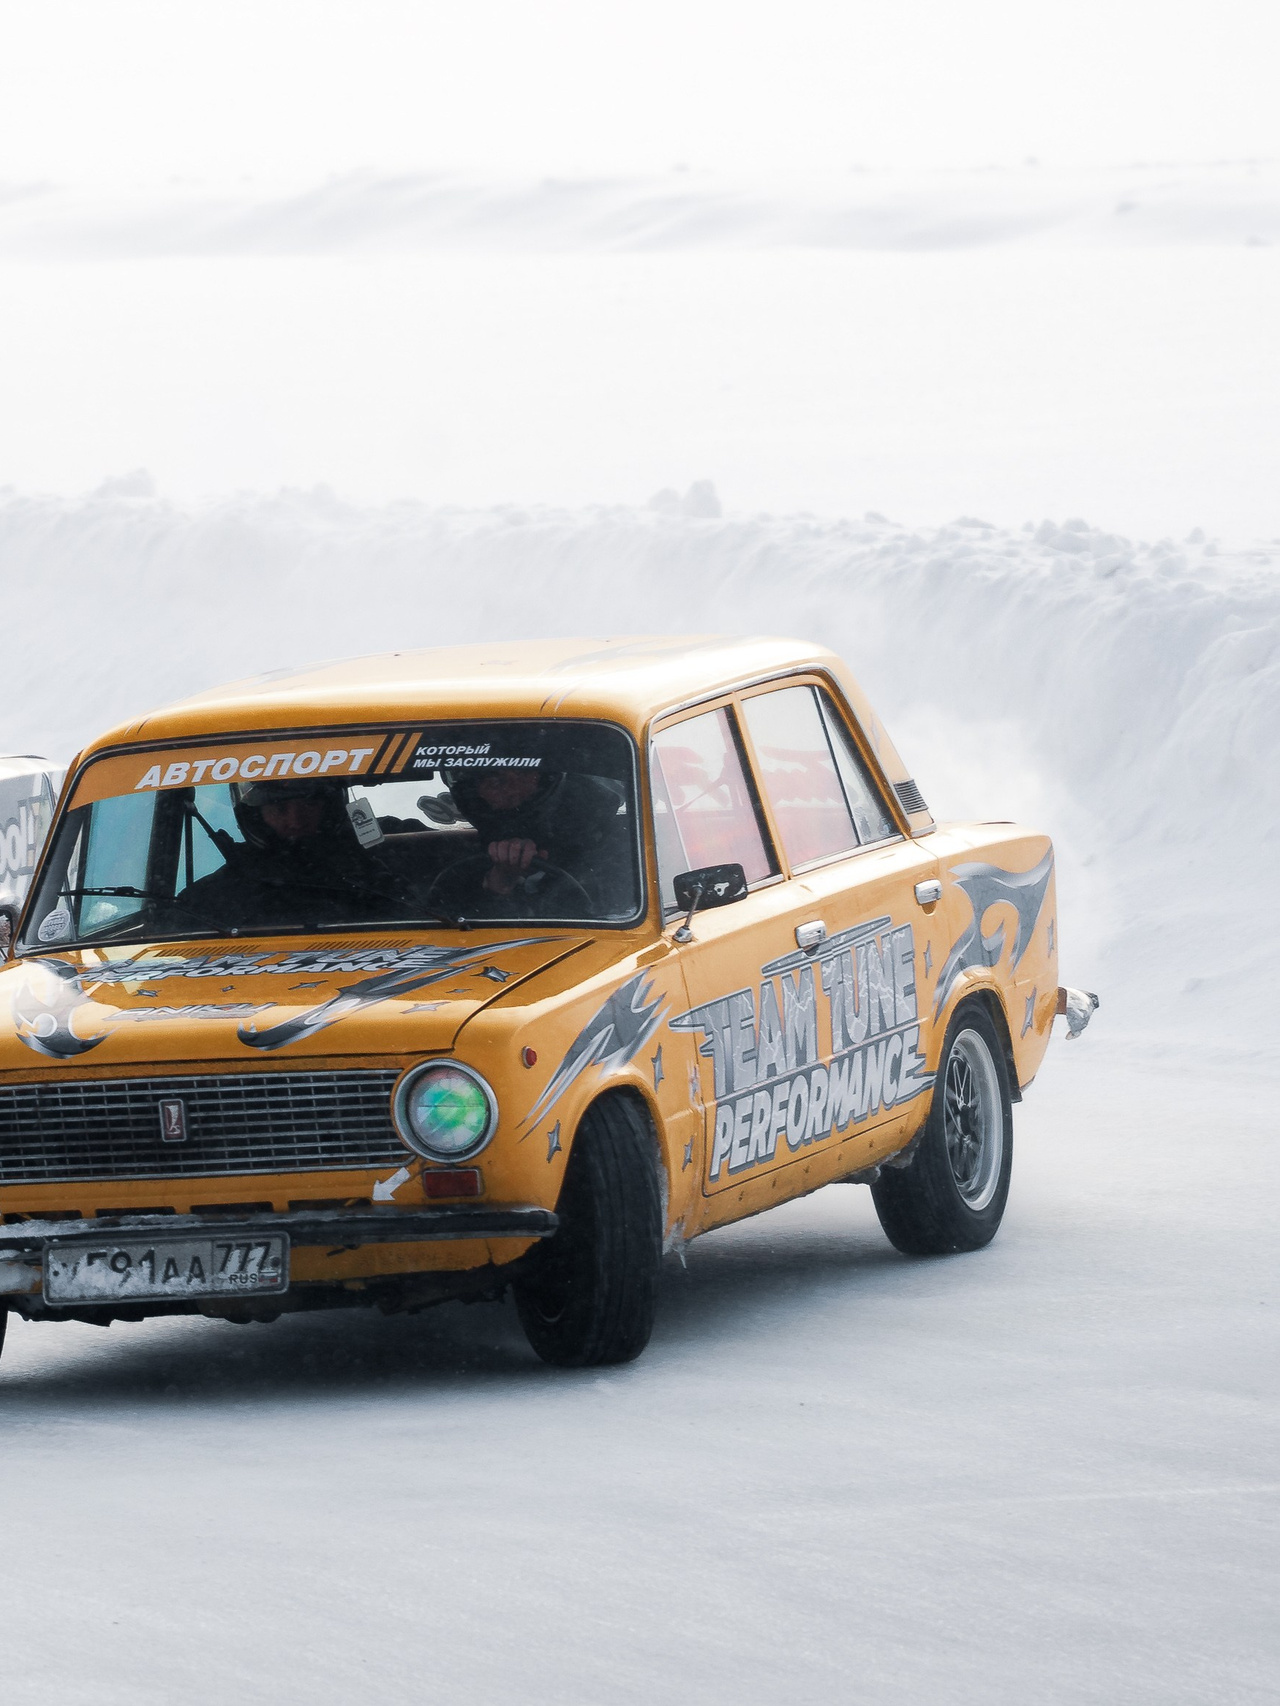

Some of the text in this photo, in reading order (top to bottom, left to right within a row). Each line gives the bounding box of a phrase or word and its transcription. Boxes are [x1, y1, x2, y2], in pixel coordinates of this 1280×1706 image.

[415, 743, 491, 756] КОТОРЫЙ
[134, 748, 374, 790] АВТОСПОРТ
[413, 757, 542, 768] МЫ ЗАСЛУЖИЛИ
[280, 945, 460, 967] TUNE
[63, 958, 444, 982] PERFORMANCE
[669, 923, 918, 1099] TEAM TUNE
[709, 1025, 936, 1182] PERFORMANCE
[215, 1241, 271, 1274] 777
[229, 1273, 258, 1284] RUS
